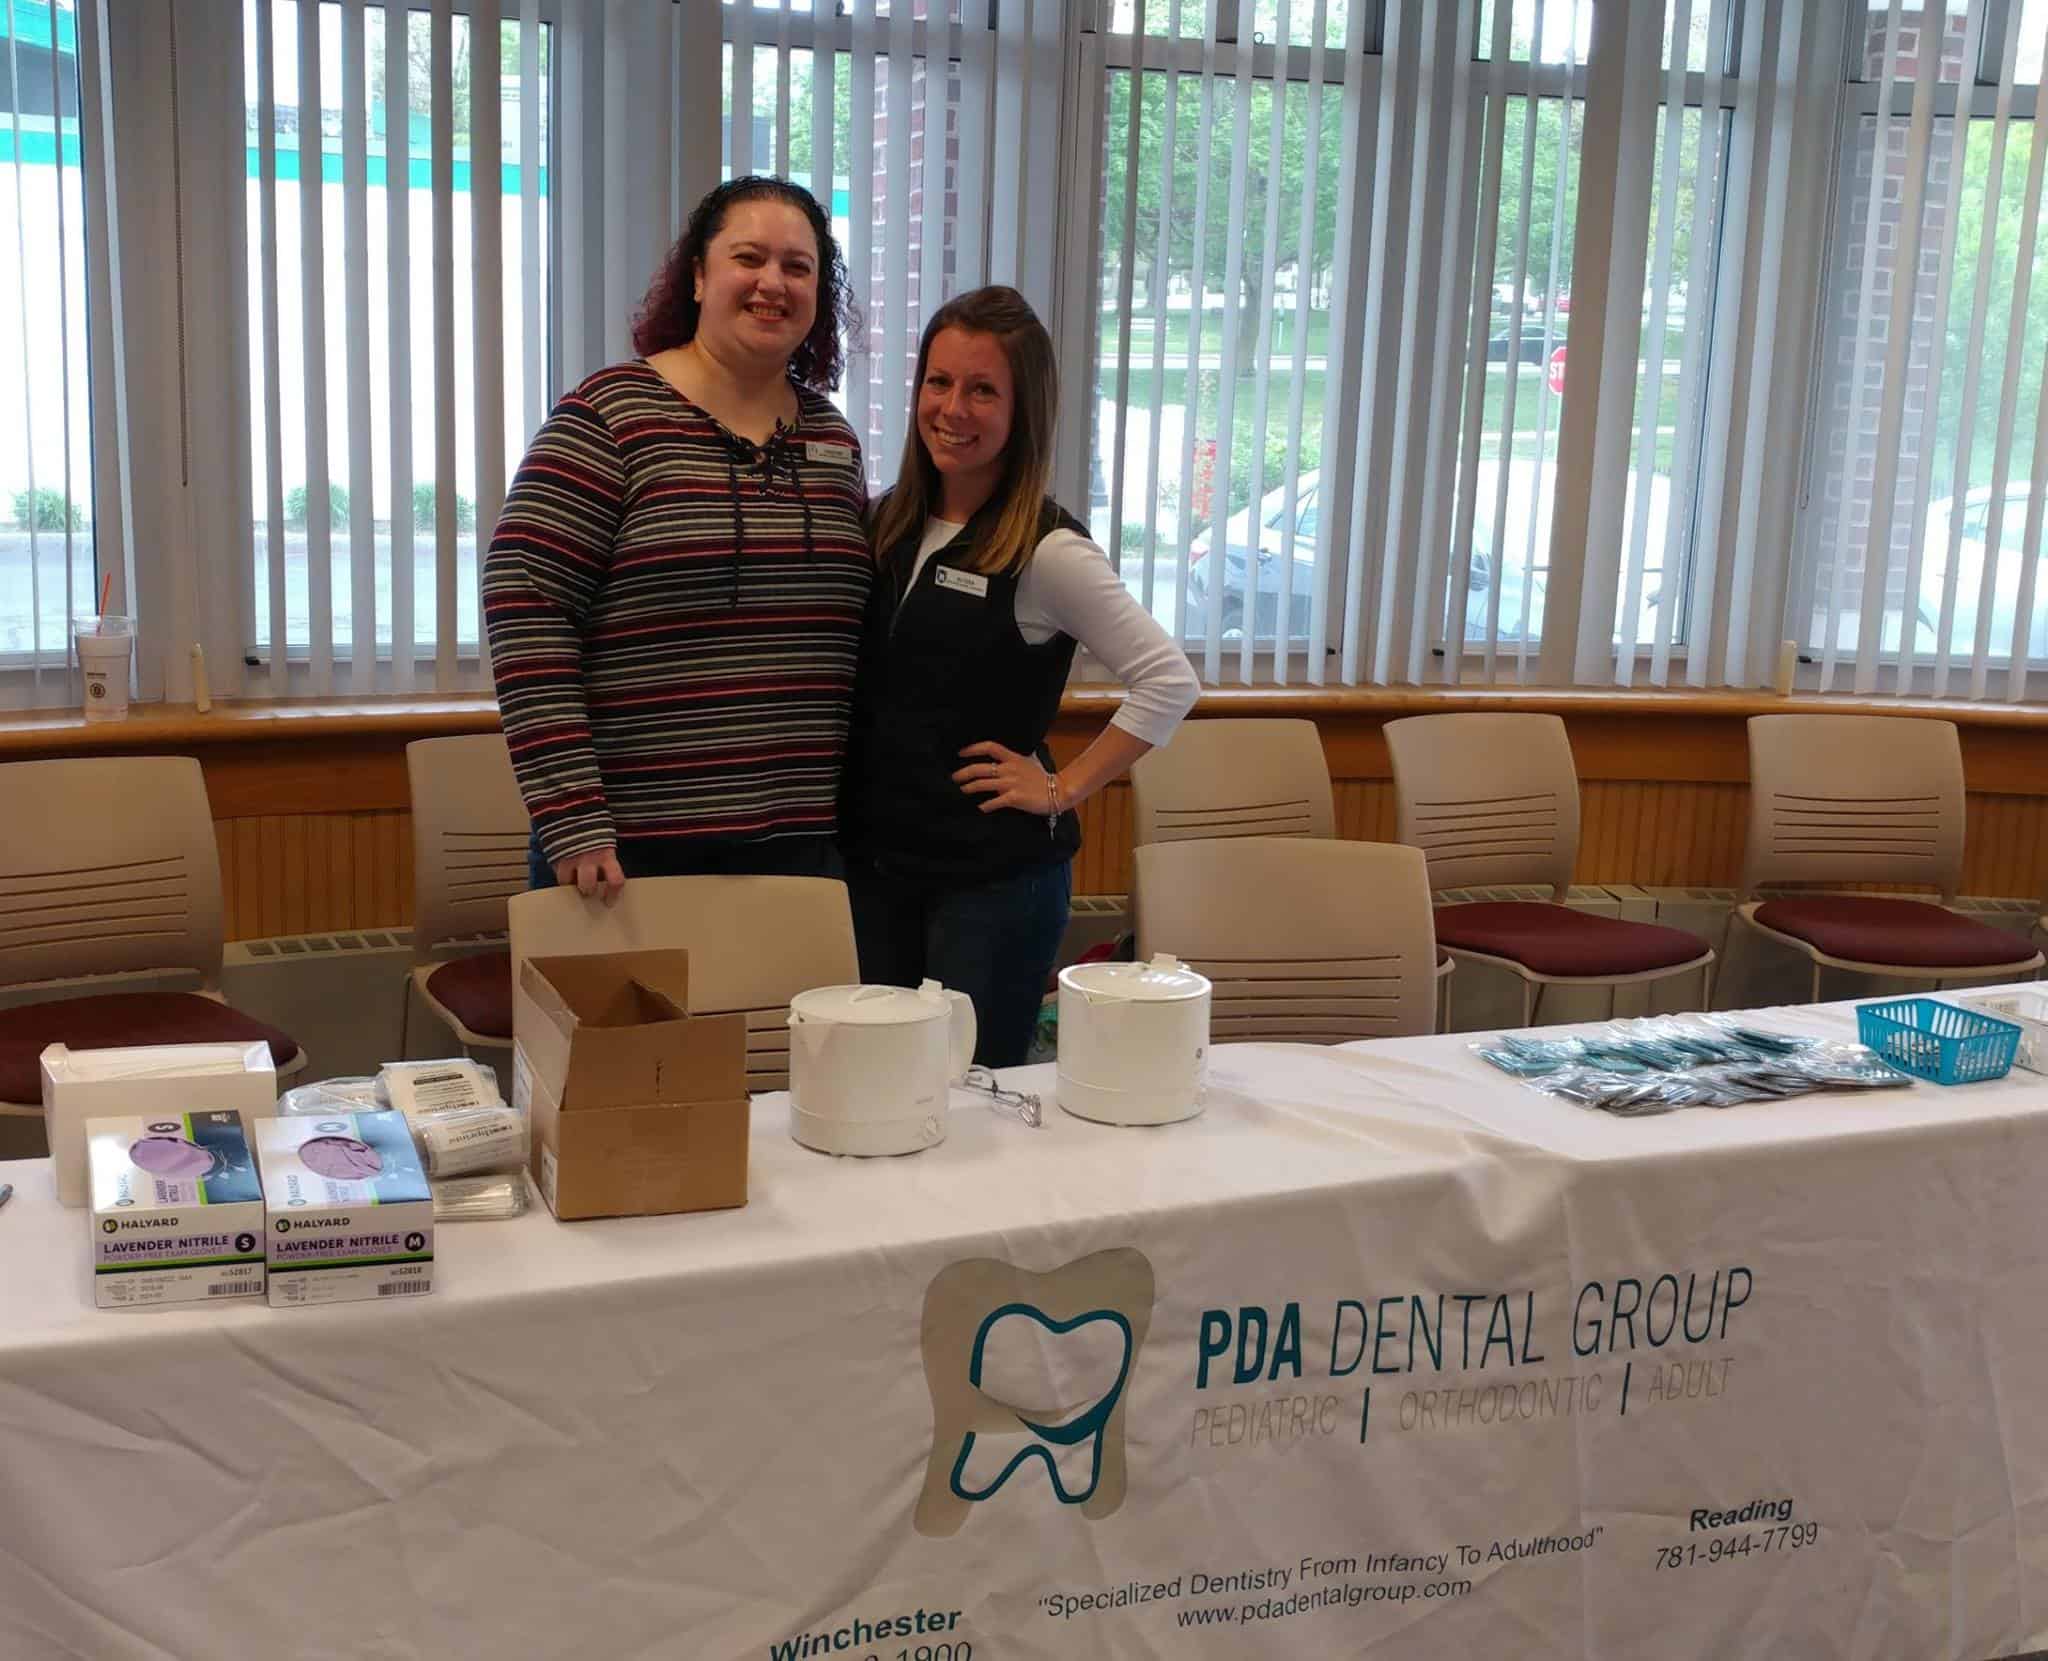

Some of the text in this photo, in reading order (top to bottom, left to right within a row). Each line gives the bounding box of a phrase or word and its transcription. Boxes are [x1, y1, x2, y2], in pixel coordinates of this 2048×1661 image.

[121, 1217, 179, 1229] HALYARD
[276, 1234, 400, 1252] LAVENDER NITRILE
[294, 1217, 350, 1229] HALYARD
[409, 1236, 421, 1247] M
[104, 1235, 229, 1254] LAVENDER NITRILE
[1196, 1267, 1753, 1389] PDA DENTAL GROUP
[1190, 1357, 1736, 1448] PEDIATRIC ORTHODONTIC ADULT
[1689, 1498, 1794, 1532] Reading
[1655, 1521, 1819, 1572] 781-944-7799
[1039, 1526, 1605, 1621] "Specialized Dentistry From Infancy To Adulthood"
[1177, 1576, 1472, 1629] www.pdadentalgroup.com
[769, 1608, 963, 1661] Winchester
